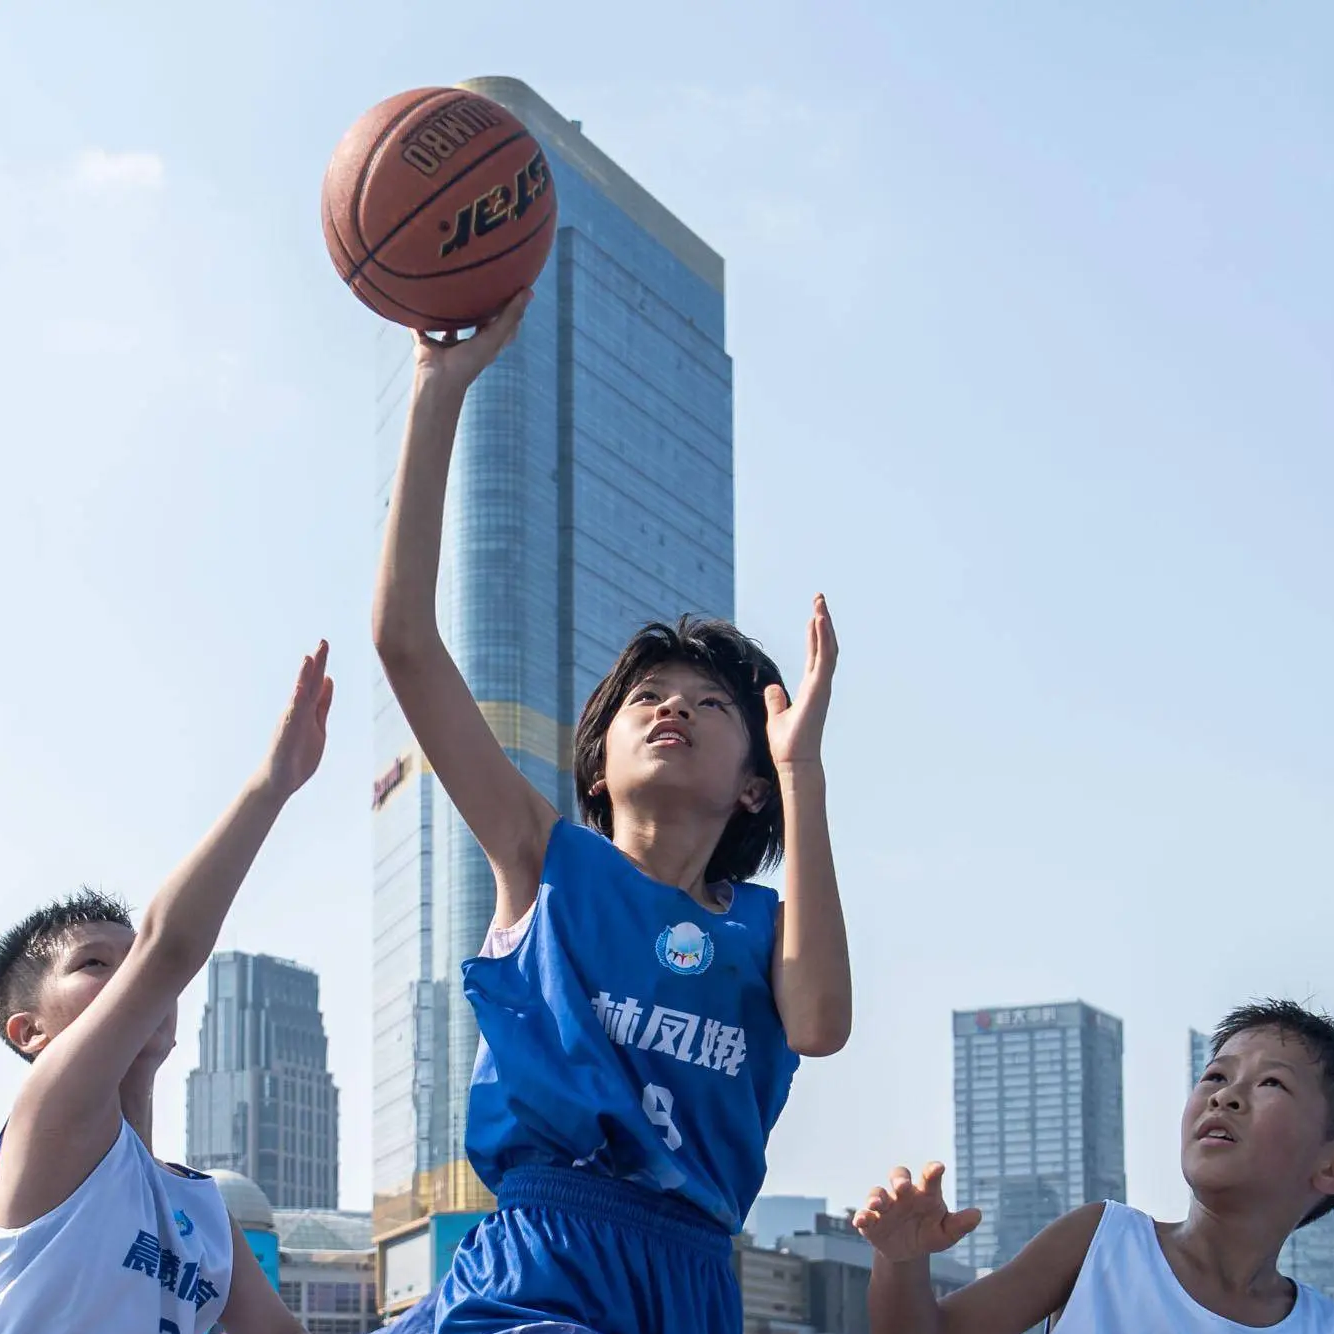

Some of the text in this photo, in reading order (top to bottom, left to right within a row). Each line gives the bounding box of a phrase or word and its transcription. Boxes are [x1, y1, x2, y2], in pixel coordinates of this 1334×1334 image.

[590, 991, 747, 1077] 林凤娥
[642, 1082, 682, 1151] 9
